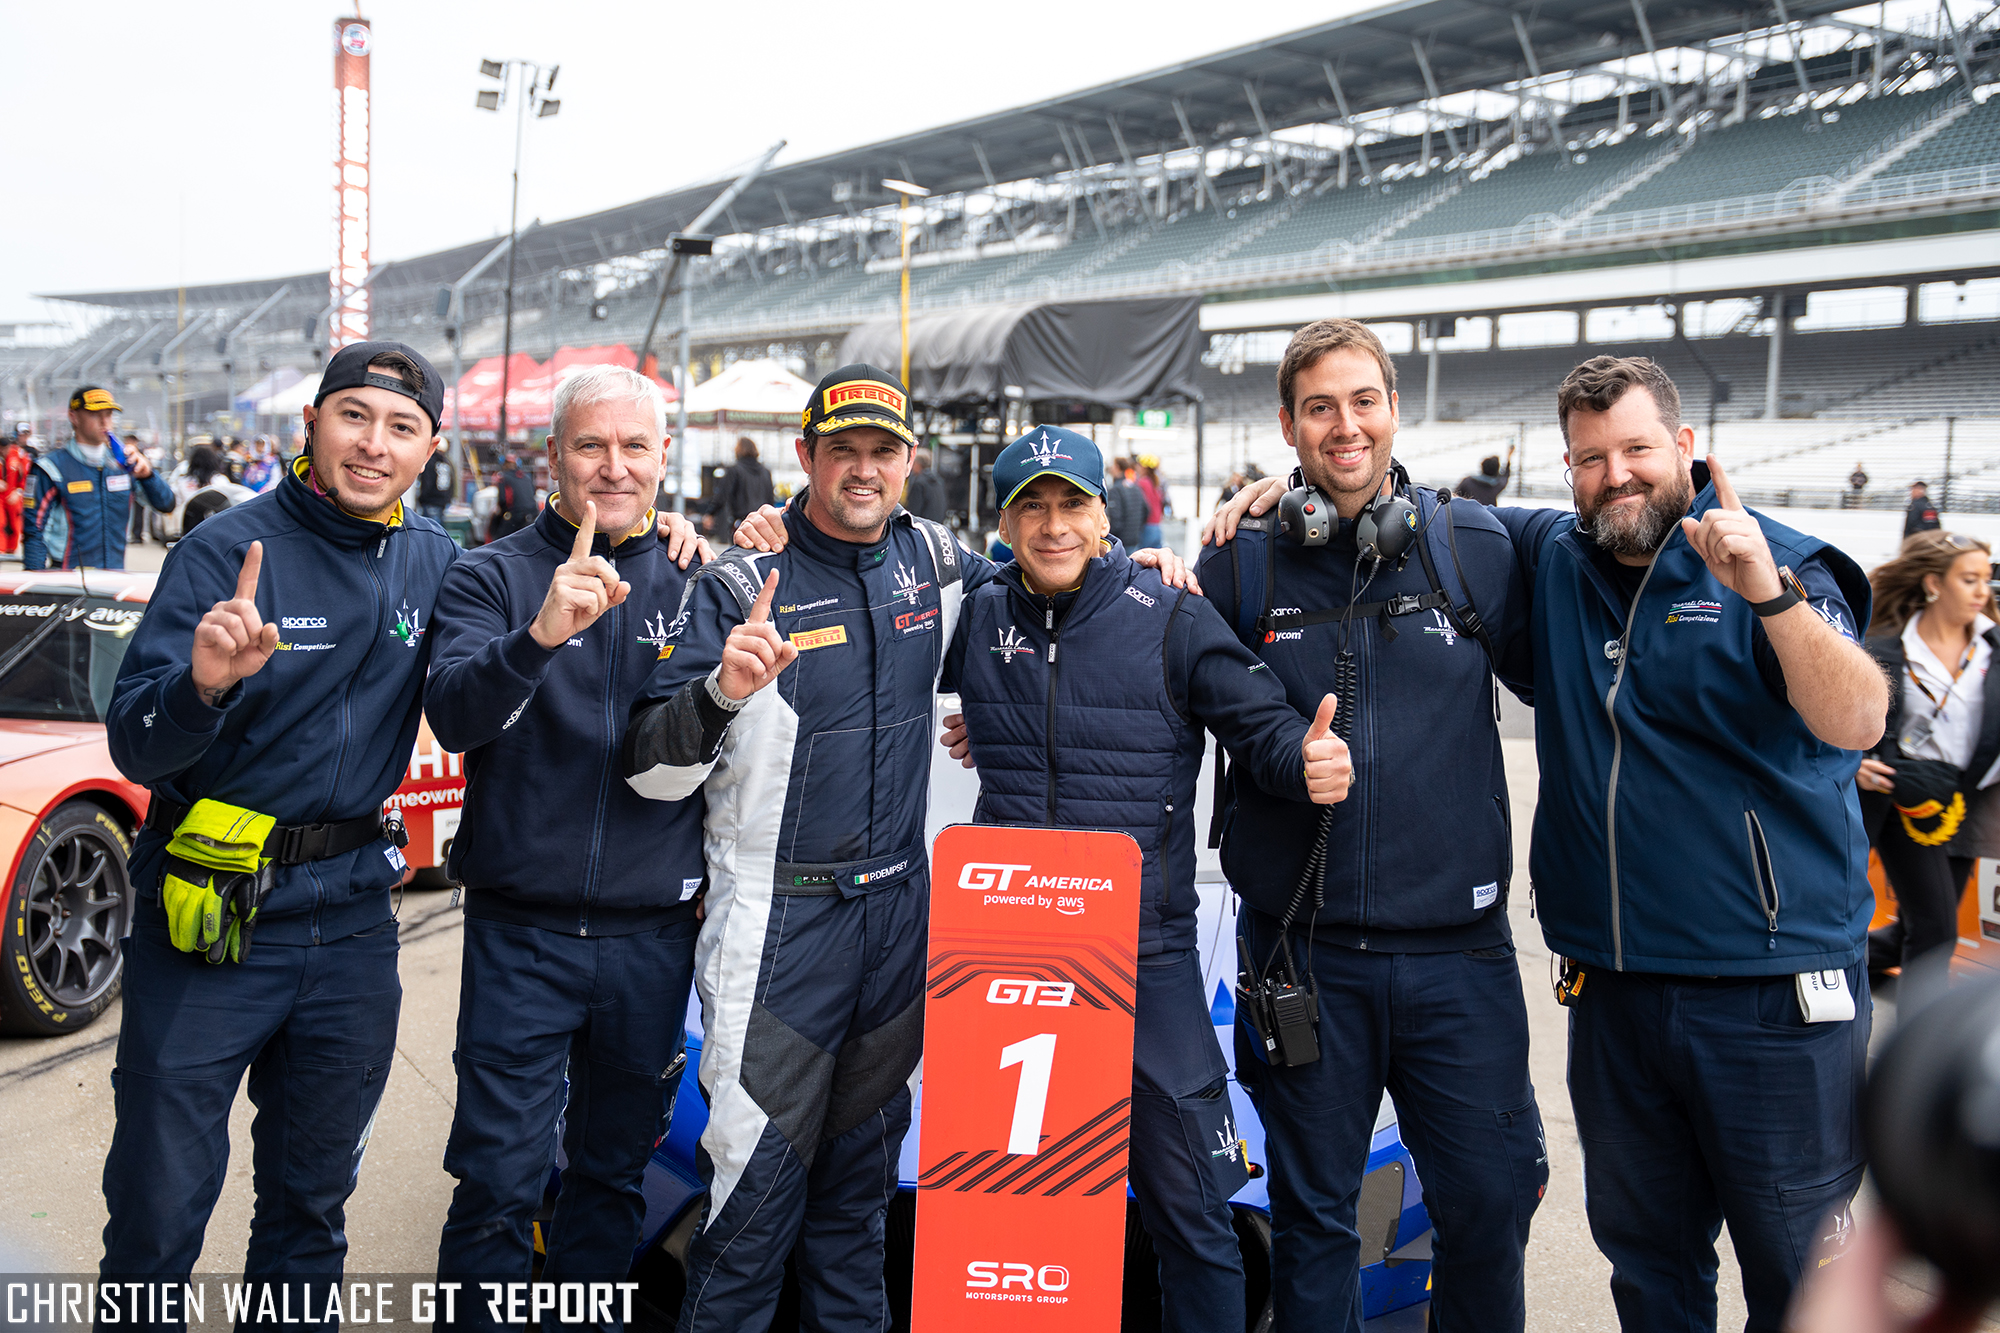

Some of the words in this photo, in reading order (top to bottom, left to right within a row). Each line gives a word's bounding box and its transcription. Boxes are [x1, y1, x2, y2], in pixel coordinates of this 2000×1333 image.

[830, 384, 902, 412] PIRELLI
[937, 525, 956, 567] sparco
[724, 562, 759, 604] sparco
[780, 604, 796, 613] Risi
[796, 598, 839, 611] Competizione
[1270, 607, 1302, 617] parco
[88, 607, 144, 629] aws
[281, 616, 328, 630] sparco
[894, 611, 914, 630] GT
[275, 641, 293, 651] Risi
[794, 628, 841, 648] PIRELLI
[1275, 631, 1303, 643] ycom
[869, 860, 909, 882] P.DEMPSEY
[958, 862, 1032, 891] GT
[1025, 875, 1113, 892] AMERICA
[983, 894, 1035, 906] powered
[1037, 894, 1053, 909] by
[1056, 896, 1085, 912] aws
[15, 954, 55, 1015] ZERO
[1810, 971, 1820, 991] ROUP
[986, 978, 1075, 1008] GT3
[51, 1011, 69, 1024] P
[998, 1033, 1058, 1156] 1
[965, 1260, 1070, 1293] SRO
[965, 1291, 1033, 1303] MOTORSPORTS
[1036, 1294, 1069, 1304] GROUP
